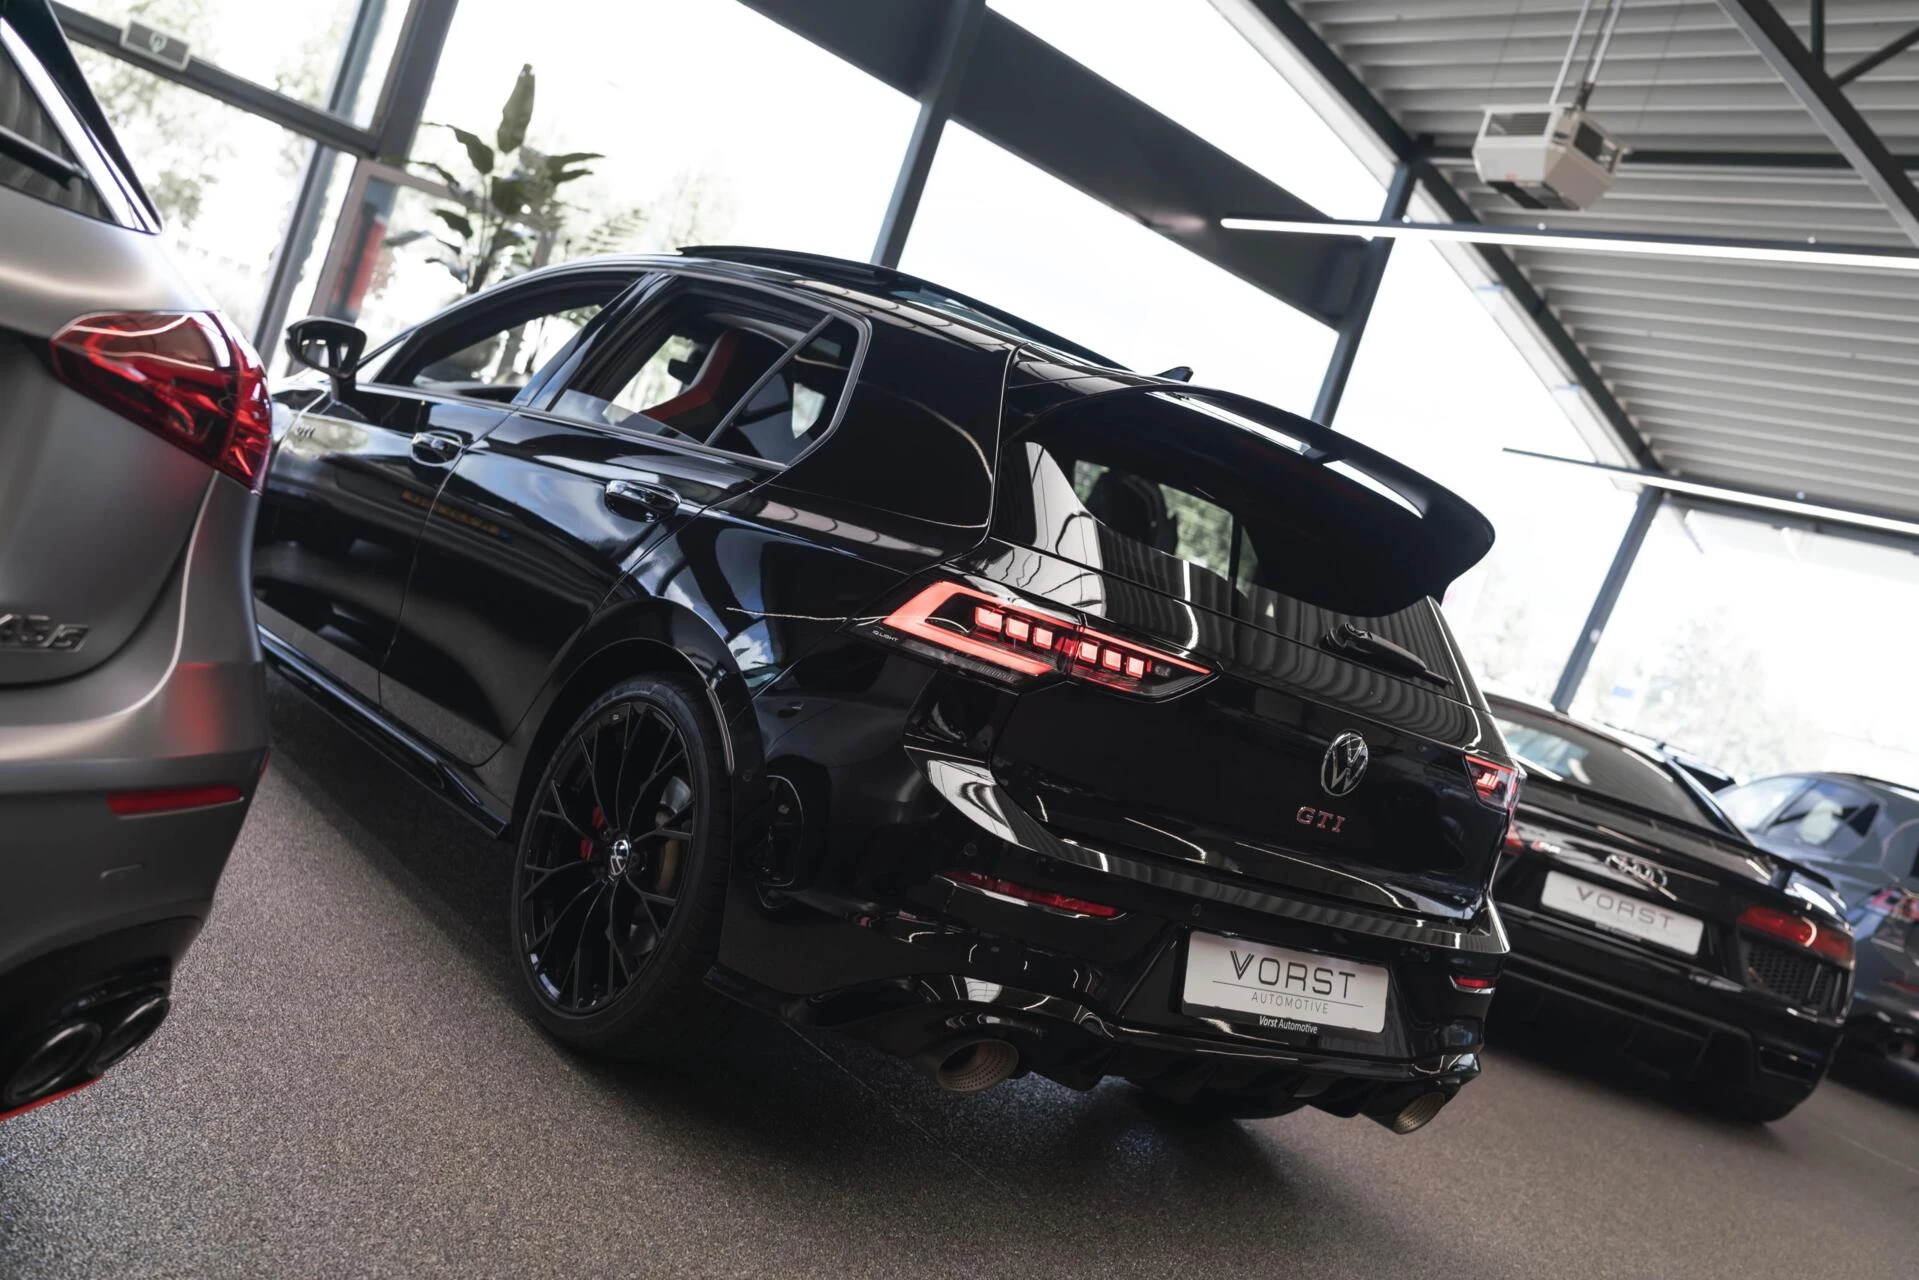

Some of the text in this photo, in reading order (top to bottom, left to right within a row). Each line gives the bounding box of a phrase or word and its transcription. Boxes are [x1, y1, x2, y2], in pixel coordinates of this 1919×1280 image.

[1296, 806, 1346, 833] GTI
[1577, 885, 1675, 929] VORST
[1230, 950, 1356, 999] VORST
[1252, 991, 1329, 1015] AUTOMOTIVE
[1259, 1015, 1318, 1034] Vorst Automotive
